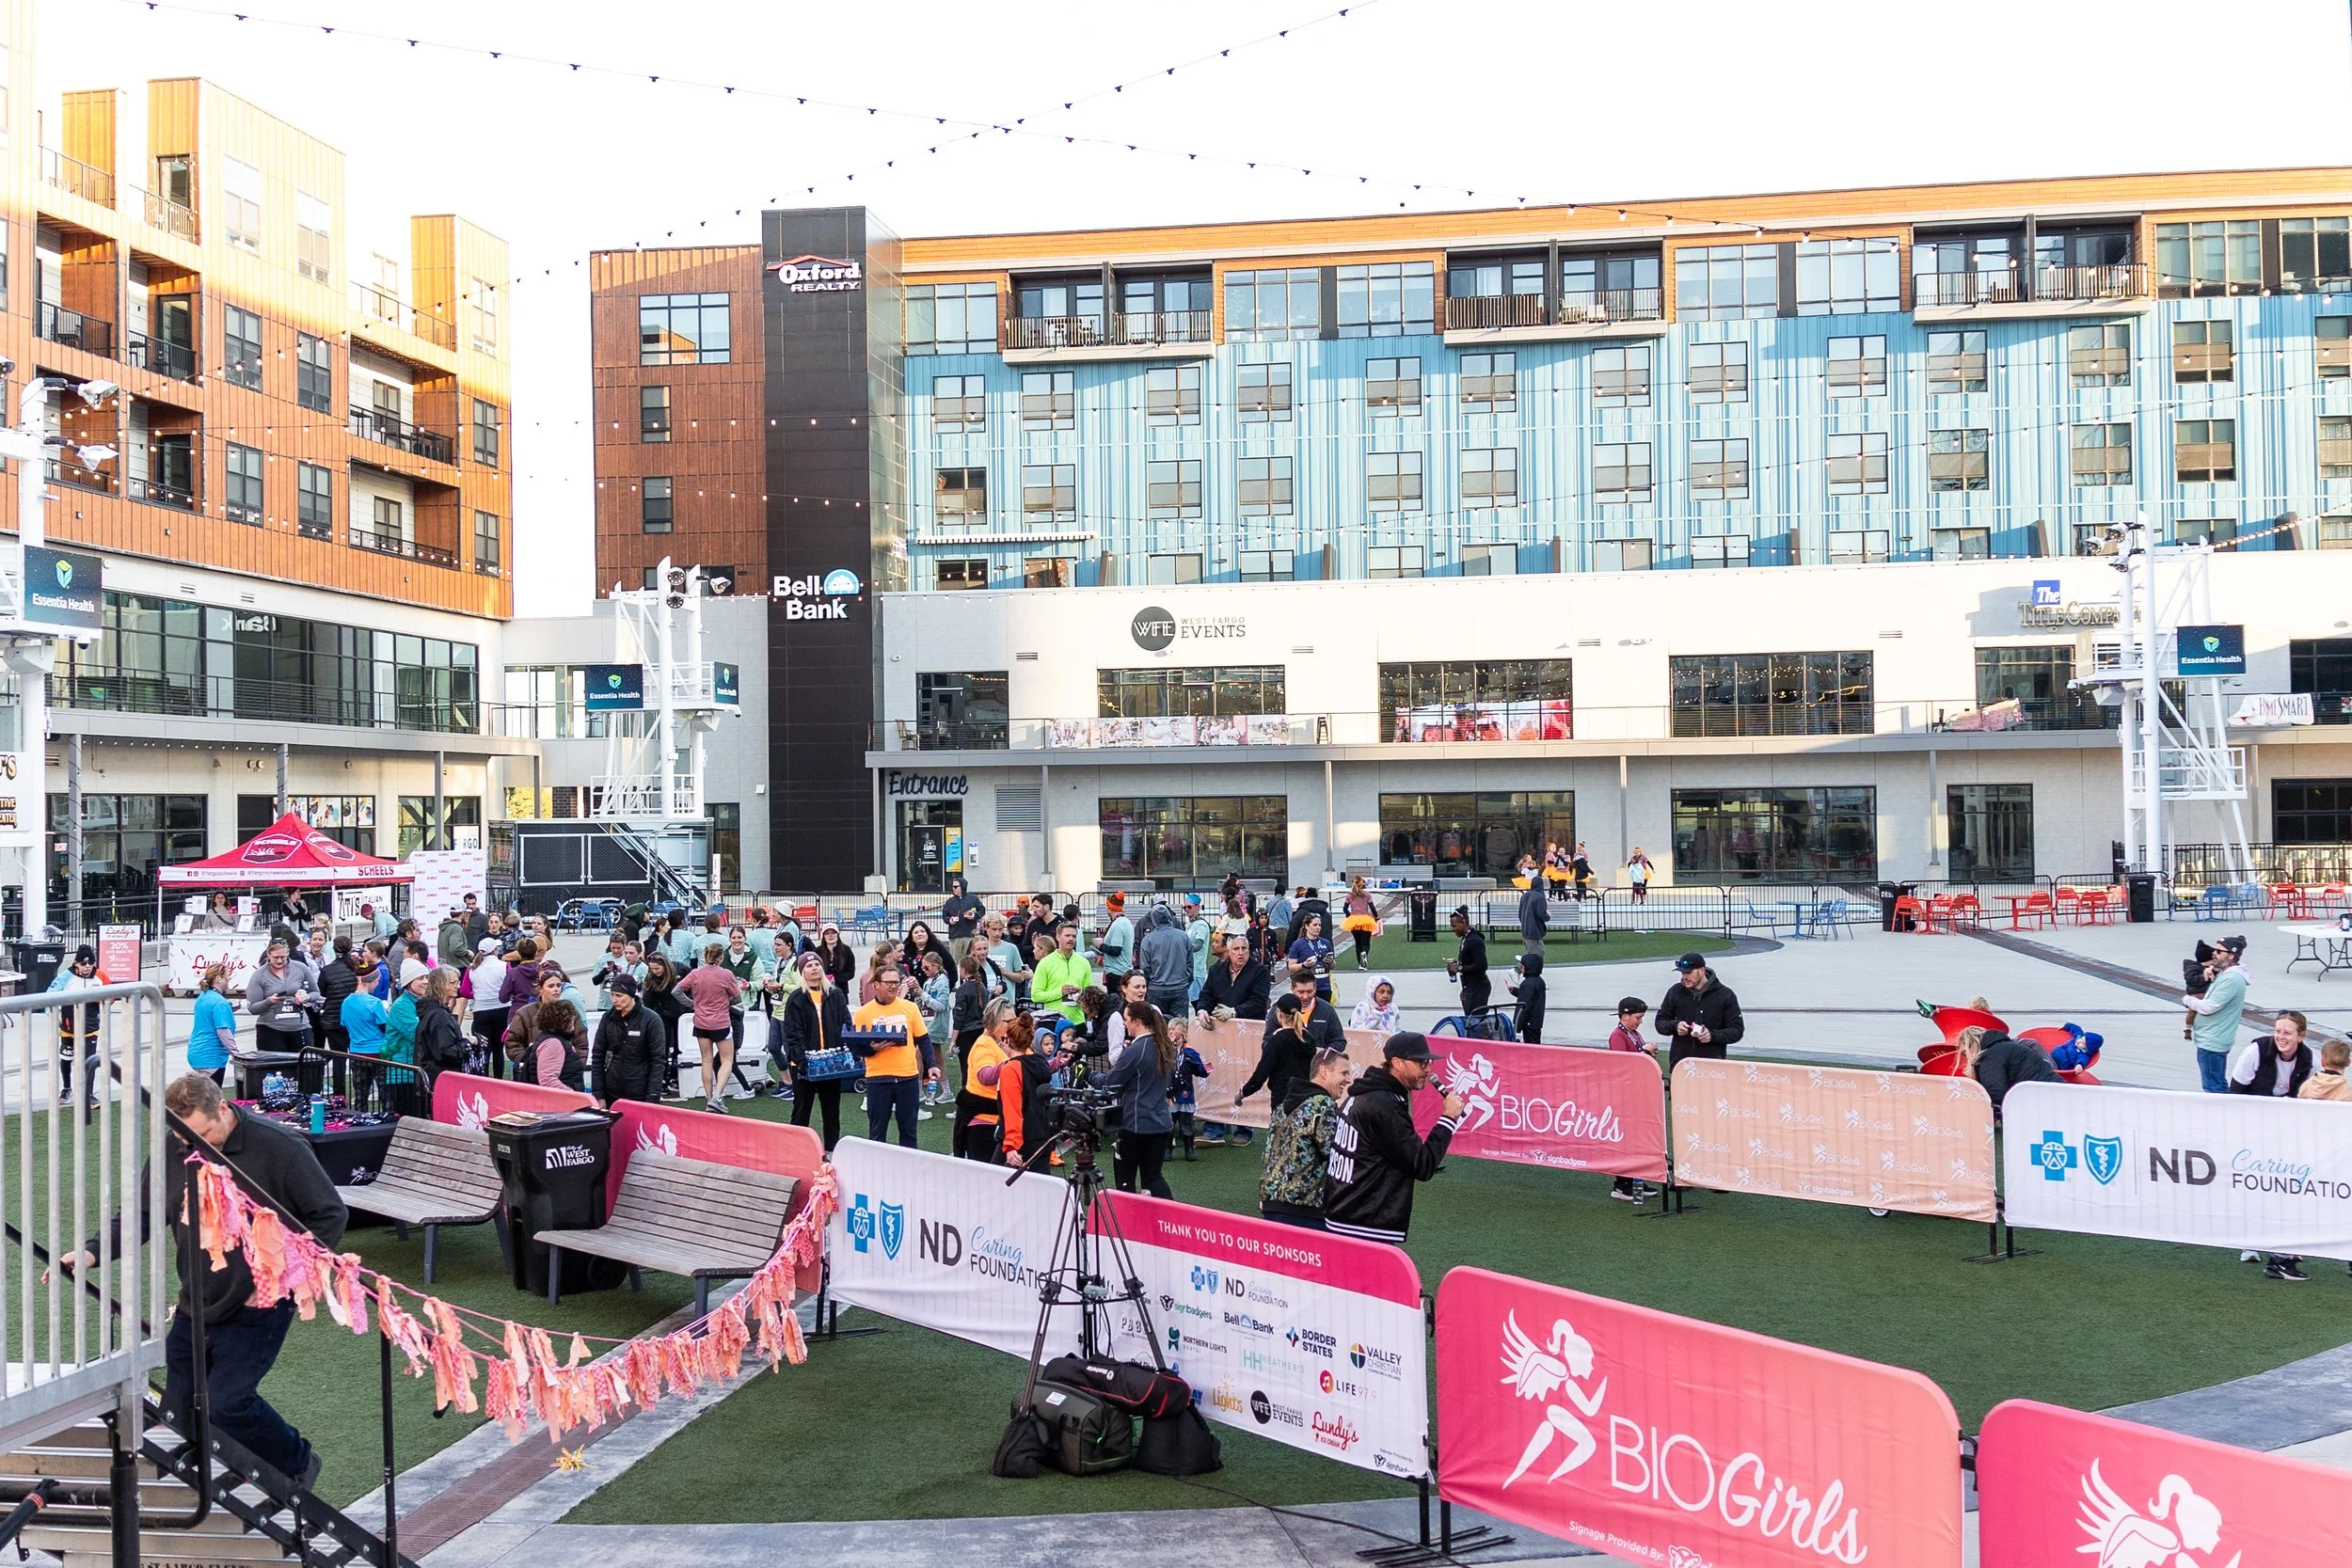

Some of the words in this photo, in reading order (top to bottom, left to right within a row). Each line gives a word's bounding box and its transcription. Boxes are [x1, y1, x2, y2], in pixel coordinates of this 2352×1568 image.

[779, 262, 860, 284] Oxford
[791, 281, 858, 293] REALTY
[773, 576, 820, 596] Bell
[2037, 586, 2060, 603] The
[32, 593, 67, 609] Essentia
[68, 598, 94, 613] Health
[787, 599, 847, 620] Bank
[1133, 620, 1174, 637] WFE
[1181, 625, 1246, 639] EVENTS
[2217, 655, 2242, 663] Health
[888, 770, 969, 795] Entrance
[453, 838, 478, 848] FRGO
[358, 865, 394, 877] SCHEELS
[110, 942, 129, 950] 20%
[192, 953, 246, 974] Ludy's
[1501, 1094, 1624, 1142] BIOGirls
[1674, 1104, 1699, 1114] OGirls
[566, 1148, 591, 1158] WEST
[566, 1155, 595, 1166] FARGO
[1547, 1155, 1587, 1166] signbadgers
[2149, 1147, 2217, 1186] ND
[2232, 1148, 2312, 1187] Caring
[2233, 1173, 2351, 1199] FOUNDATIO
[920, 1218, 962, 1267] ND
[971, 1226, 1025, 1272] Caring
[1158, 1220, 1192, 1239] THANK
[1194, 1228, 1216, 1243] YOU
[1219, 1233, 1233, 1247] TO
[1236, 1237, 1260, 1254] OUR
[1263, 1243, 1322, 1267] SPONSORS
[970, 1253, 1049, 1290] FOUNDATIO
[1225, 1276, 1246, 1298] ND
[1248, 1291, 1289, 1309] FOUNDATION
[1174, 1302, 1213, 1320] signbadgers
[1224, 1312, 1240, 1326] Bell
[1252, 1320, 1274, 1335] Bank
[1183, 1336, 1209, 1349] NORTHERN
[1210, 1338, 1227, 1353] LIGHTS
[1302, 1328, 1337, 1347] BORDER
[1302, 1341, 1333, 1358] STATES
[1366, 1346, 1402, 1366] VALLEY
[1367, 1358, 1402, 1376] CHRISTIAN
[1336, 1379, 1356, 1396] LIFE
[1358, 1386, 1377, 1402] 97.9
[1273, 1409, 1304, 1427] EVENTS
[1311, 1411, 1359, 1450] Lundy's
[1610, 1414, 1868, 1565] BIOGirls
[1569, 1520, 1606, 1542] Signage
[1607, 1533, 1646, 1555] Provided
[1649, 1547, 1664, 1561] By:
